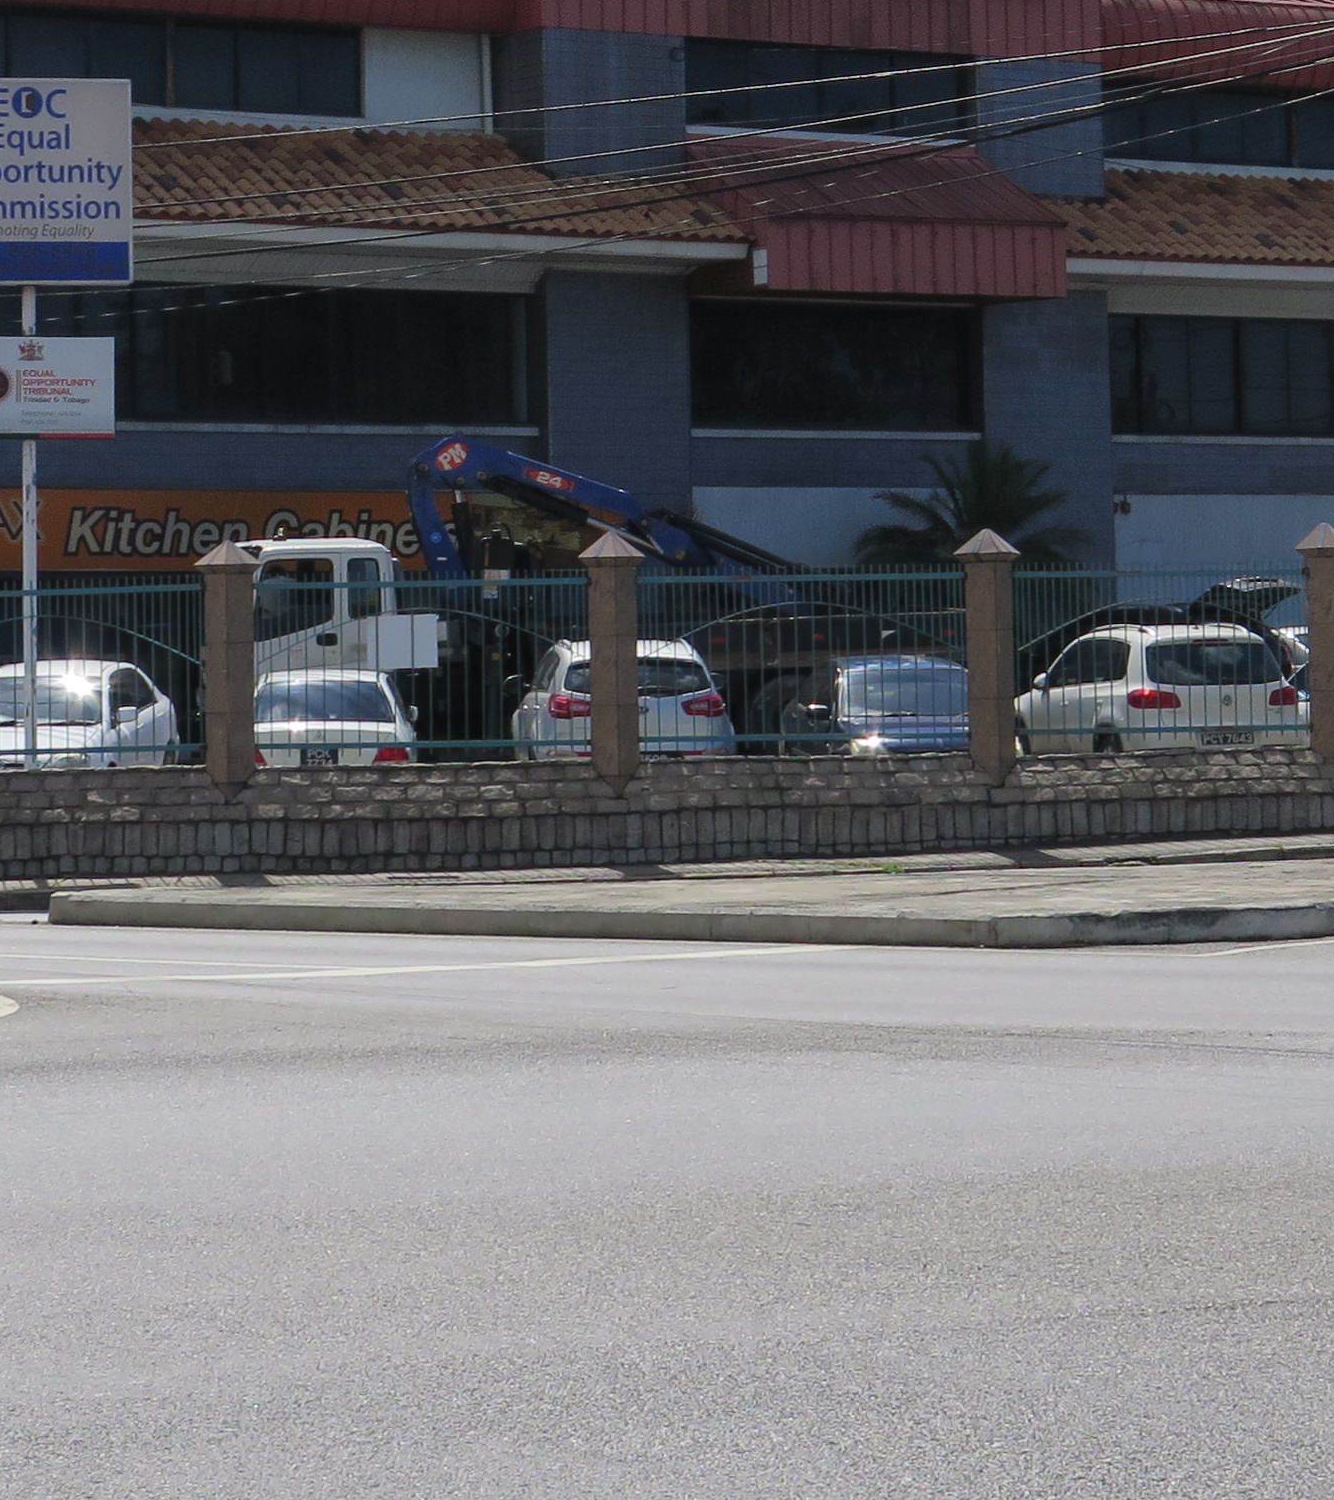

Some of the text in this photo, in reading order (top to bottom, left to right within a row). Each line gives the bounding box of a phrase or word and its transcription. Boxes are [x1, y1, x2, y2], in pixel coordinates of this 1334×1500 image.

[41, 224, 95, 239] Equality
[22, 369, 56, 377] EQUAL
[22, 378, 97, 387] OPPORTUNITY
[22, 387, 73, 396] TRIBUNAL
[437, 443, 468, 471] PM
[535, 470, 564, 488] 24
[65, 507, 249, 556] Kitchen
